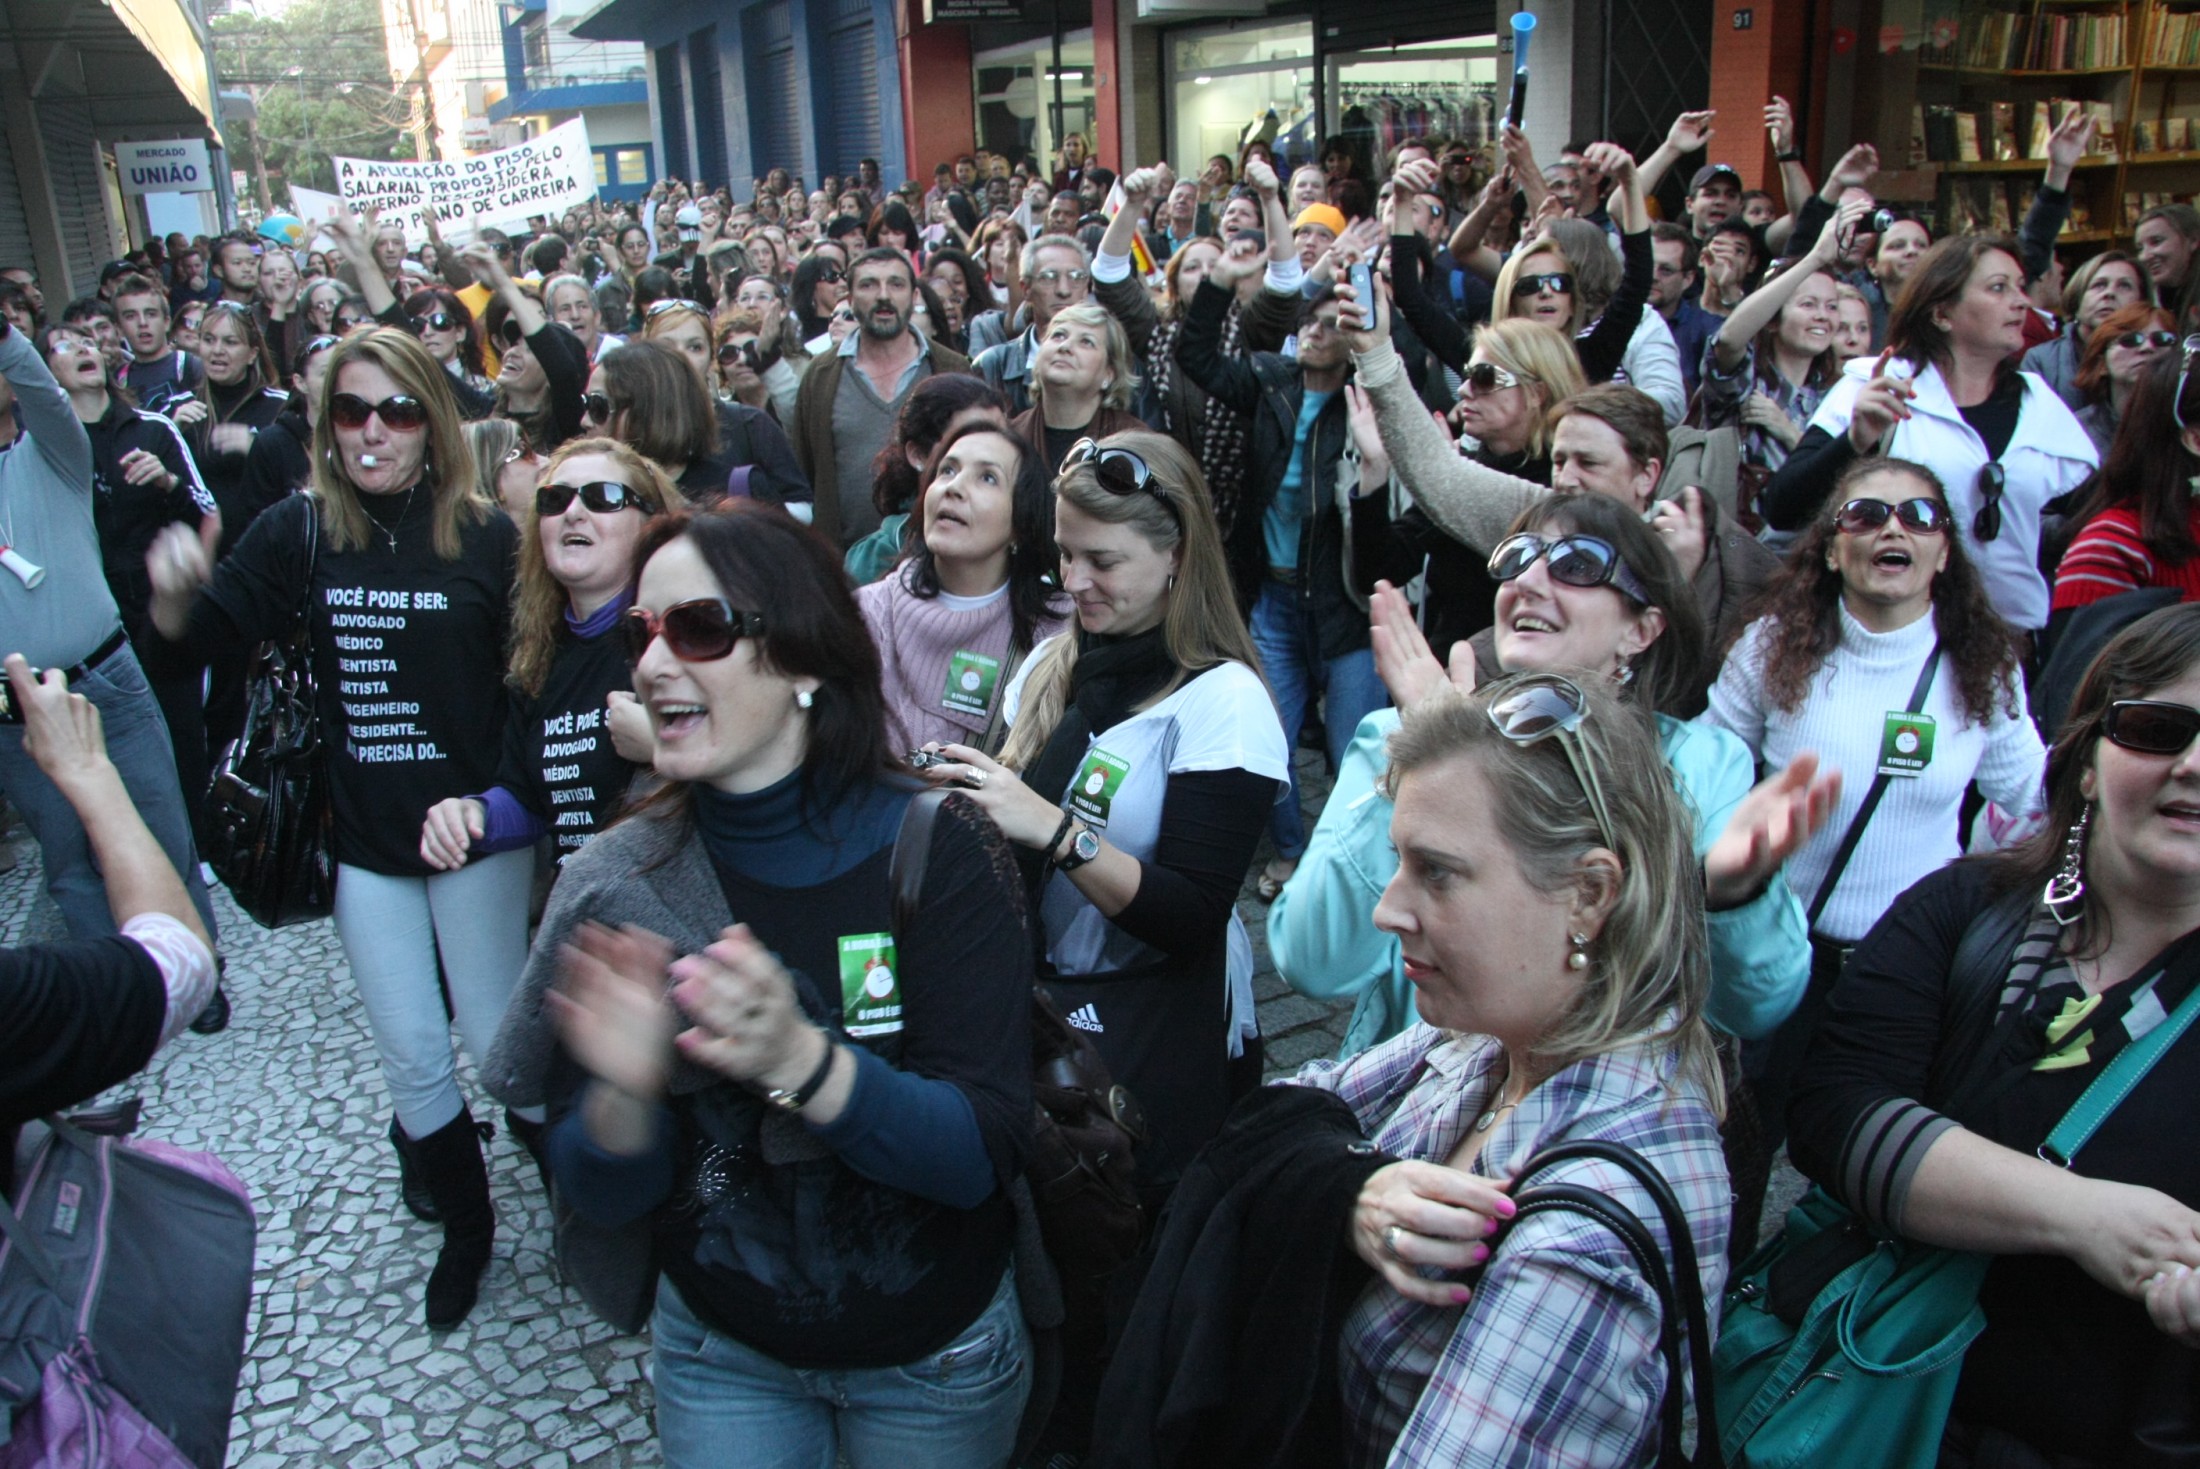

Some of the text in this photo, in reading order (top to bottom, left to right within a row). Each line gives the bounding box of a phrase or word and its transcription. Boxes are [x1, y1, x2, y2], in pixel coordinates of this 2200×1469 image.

[1733, 13, 1749, 28] 91
[136, 148, 186, 158] MERCADO
[342, 147, 533, 180] A APLICAÇÃO DO PISO
[344, 146, 563, 198] SALARIAL PROPOSTO PELO
[131, 162, 197, 185] UNIÃO
[431, 168, 553, 203] DESCONSIDERA
[473, 195, 493, 214] DE
[499, 176, 577, 207] CARREIRA
[326, 586, 448, 610] VOCÊ PODE SER:
[332, 614, 406, 630] ADVOGADO
[335, 634, 383, 650] MÉDICO
[359, 743, 414, 763] PRECISA
[418, 743, 447, 760] DO...
[543, 737, 596, 758] ADVOGADO
[1892, 757, 1907, 766] PISO
[543, 764, 580, 782] MÉDICO
[551, 787, 595, 804] DENTISTA
[555, 811, 594, 825] ARTISTA
[866, 1007, 885, 1020] PISO
